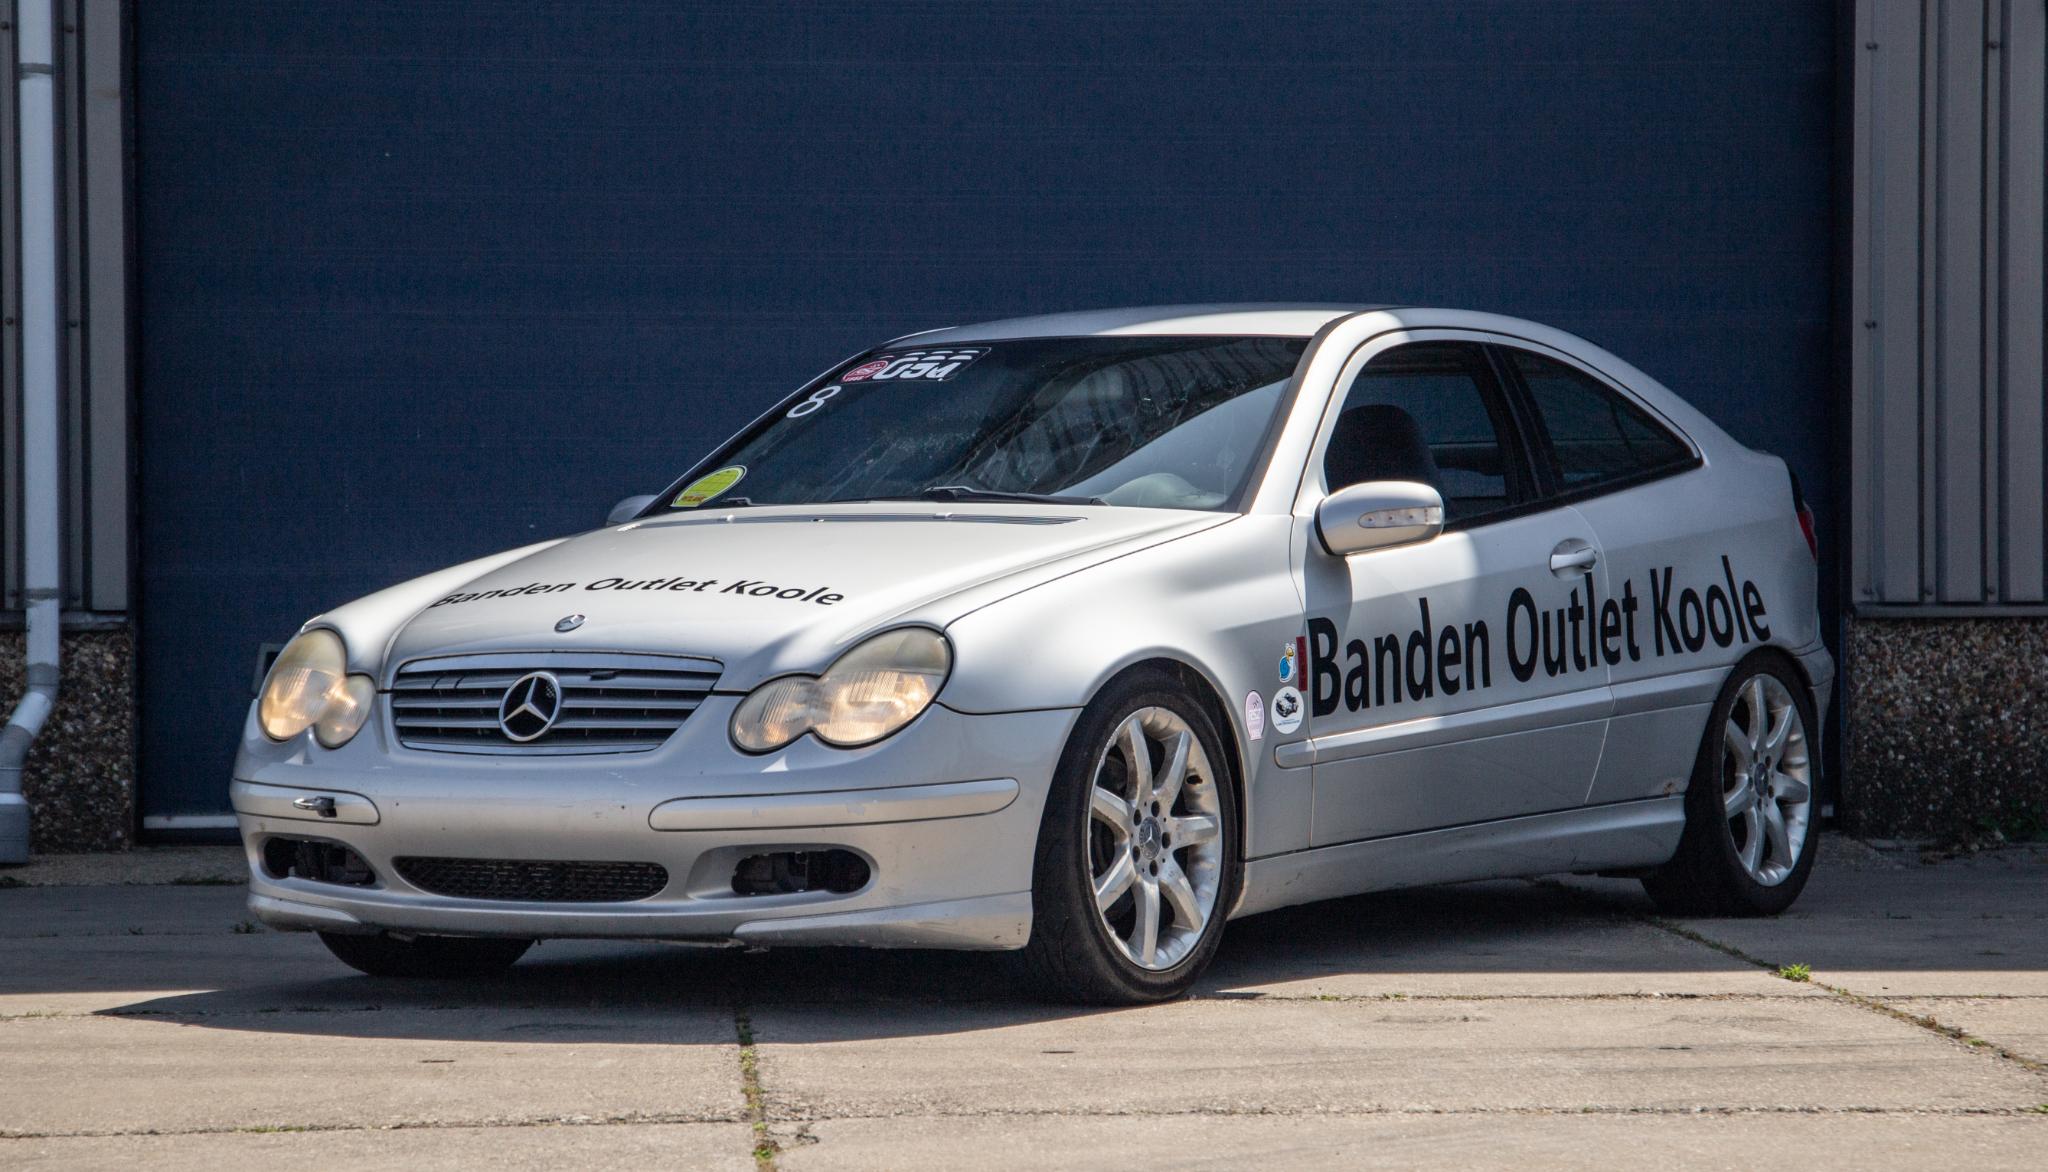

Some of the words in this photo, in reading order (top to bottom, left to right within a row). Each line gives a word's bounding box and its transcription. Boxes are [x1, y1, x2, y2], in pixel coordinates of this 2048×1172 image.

[786, 385, 842, 418] 8
[428, 582, 577, 608] Banden
[584, 576, 719, 593] Outlet
[721, 579, 845, 606] Koole
[1308, 597, 1492, 718] Banden
[1506, 572, 1641, 683] Outlet
[1650, 555, 1772, 657] Koole
